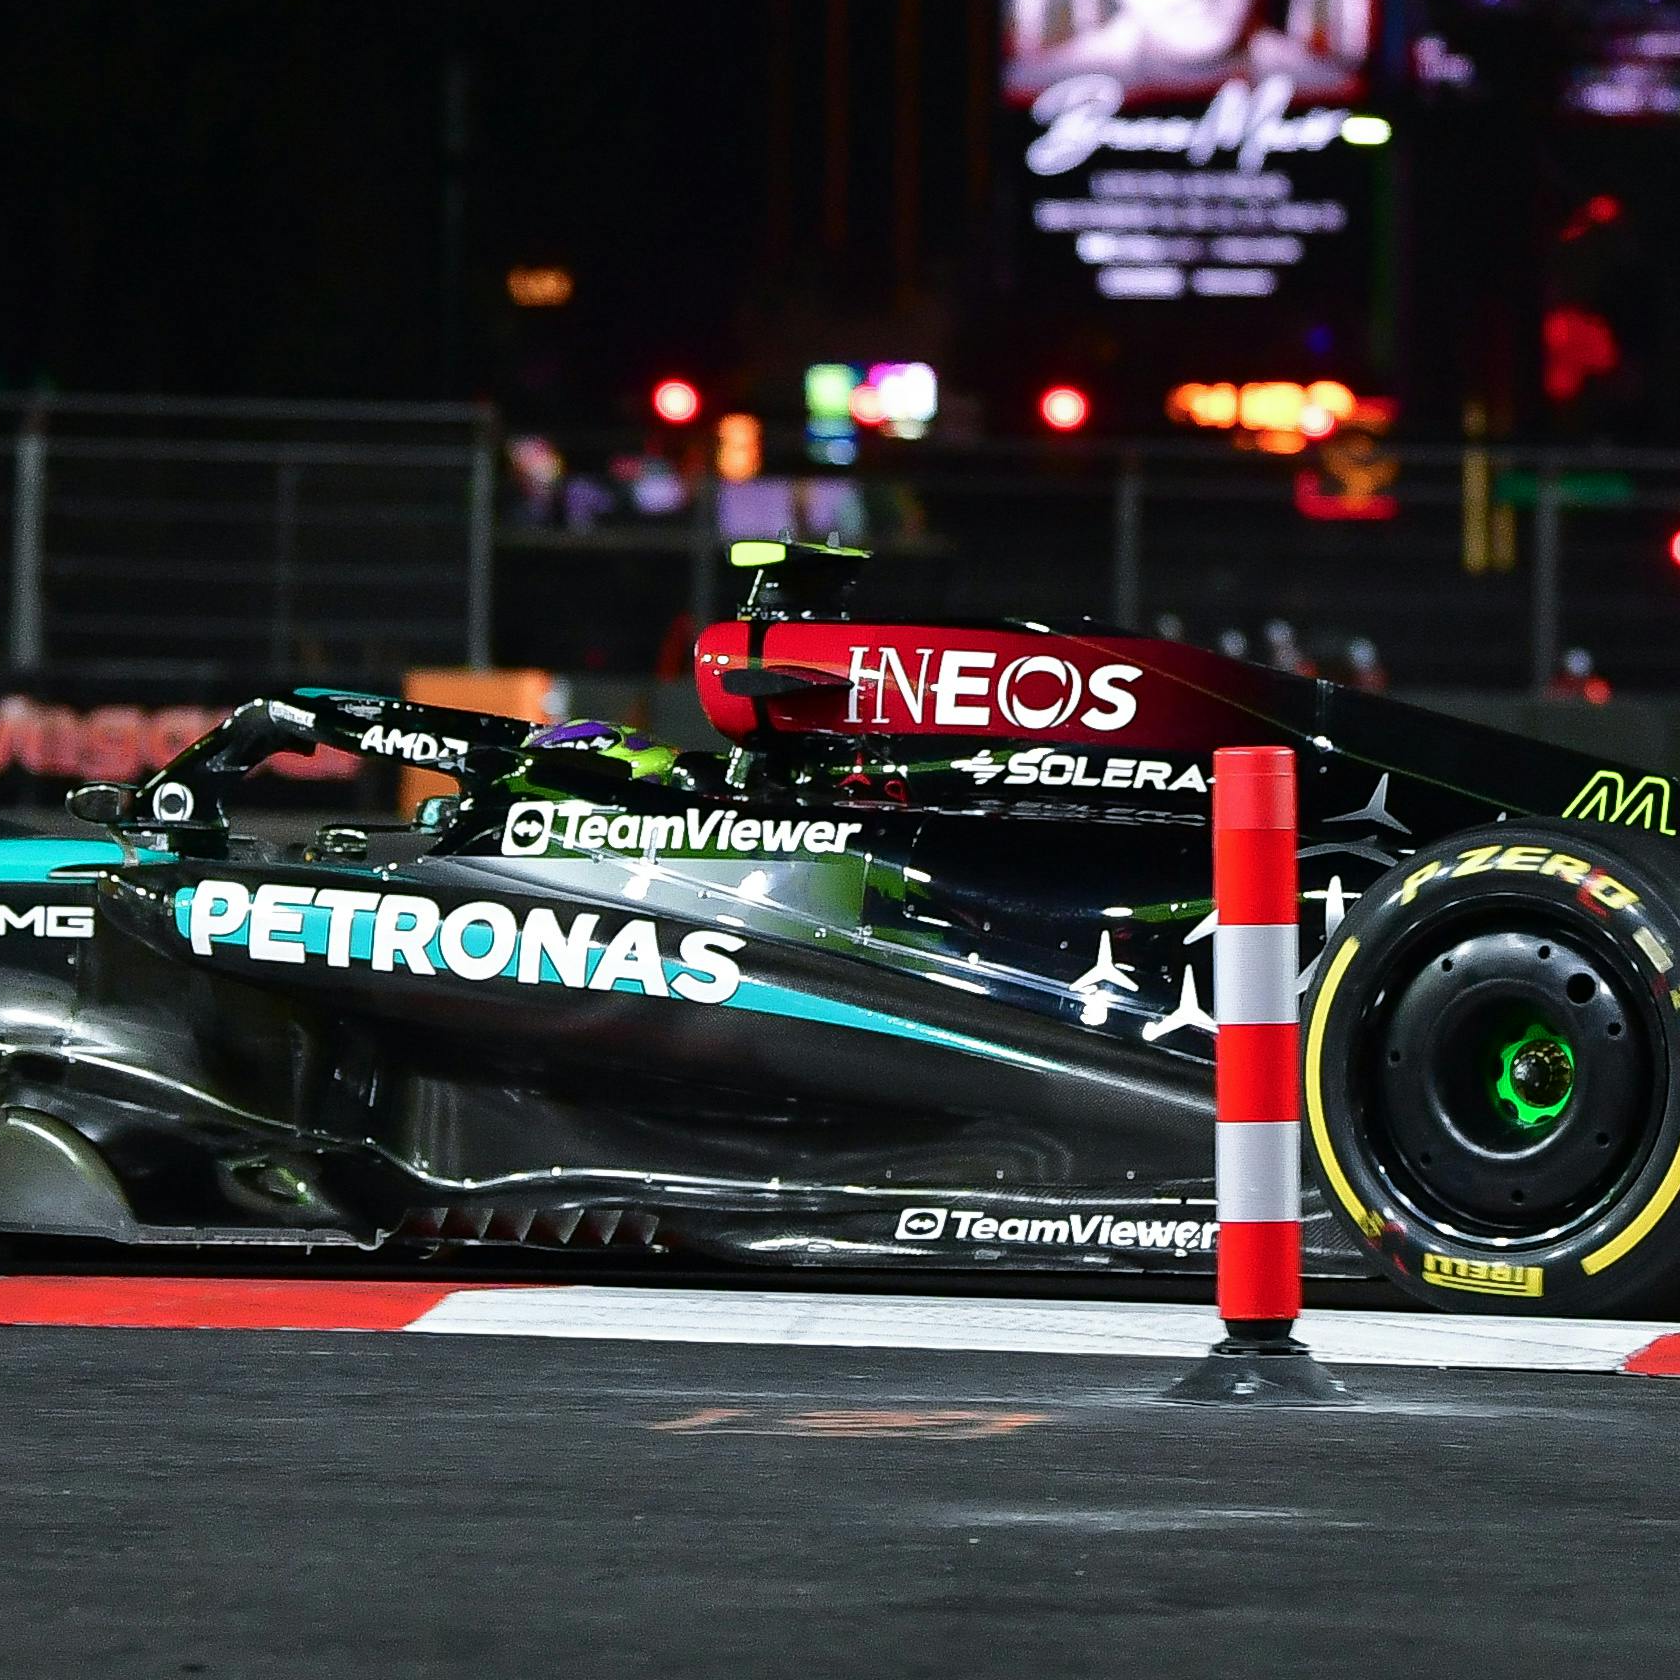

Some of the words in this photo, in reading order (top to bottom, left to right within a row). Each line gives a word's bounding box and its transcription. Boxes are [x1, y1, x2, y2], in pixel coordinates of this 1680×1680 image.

[1004, 747, 1208, 793] SOLERA
[559, 806, 862, 854] TeamViewer
[187, 879, 748, 1005] PETRONAS
[950, 1210, 1219, 1251] TeamViewer
